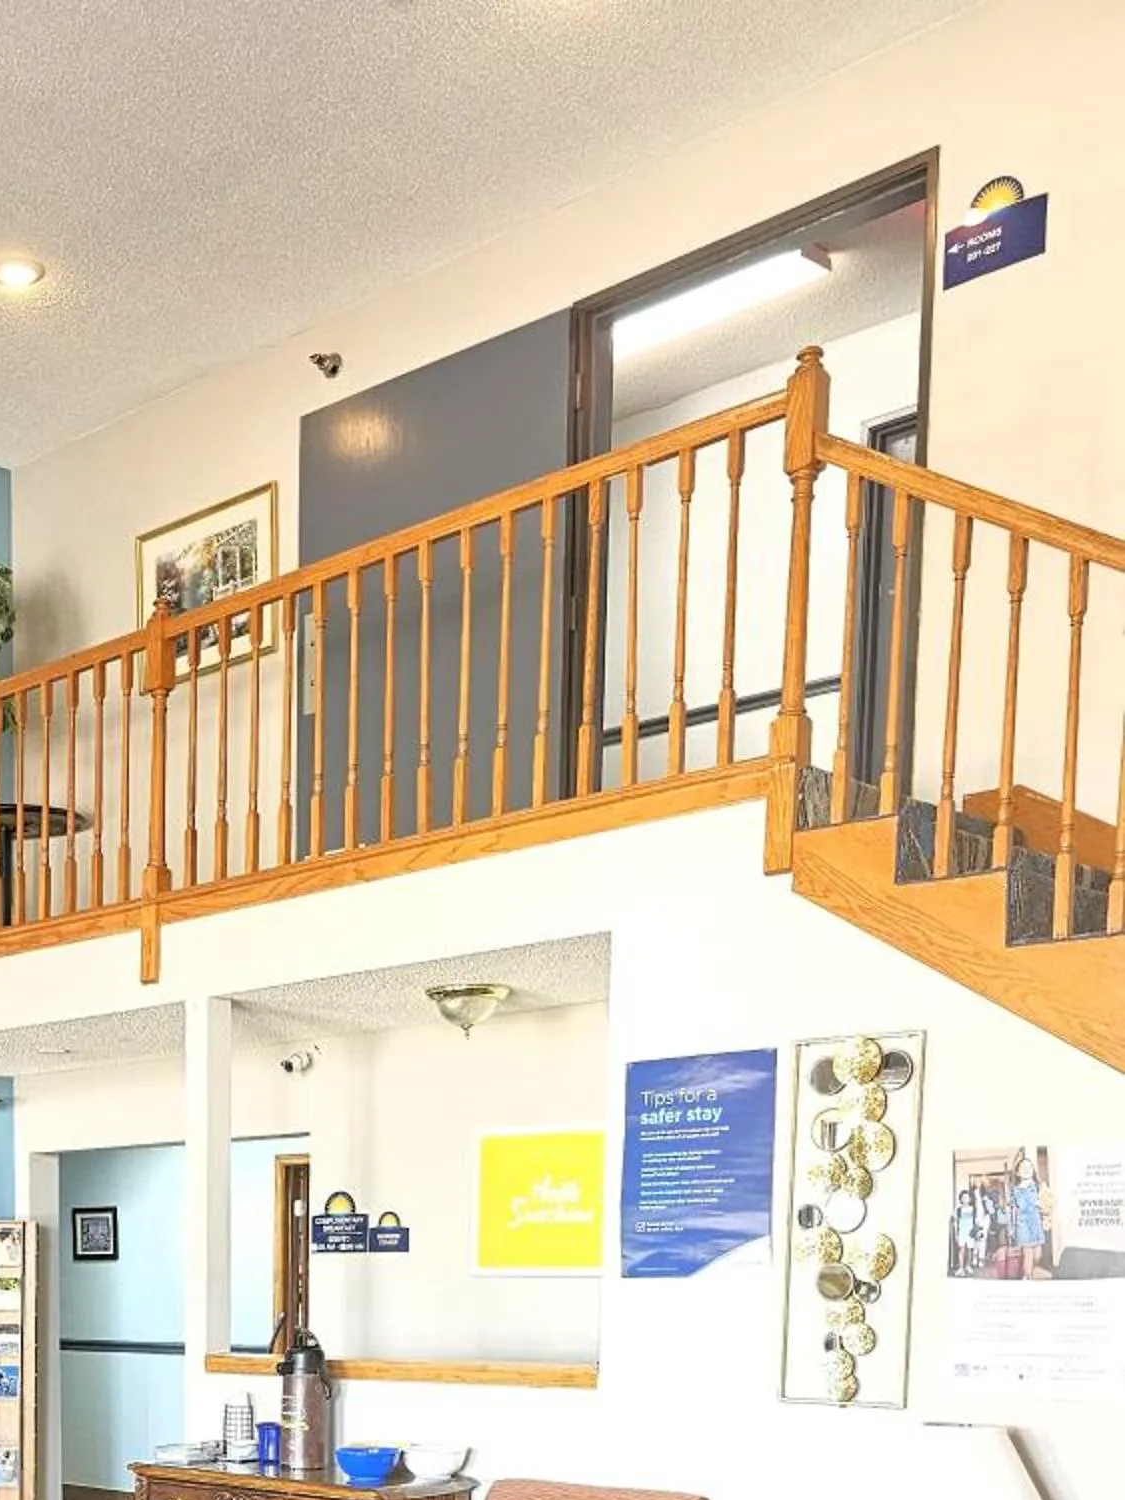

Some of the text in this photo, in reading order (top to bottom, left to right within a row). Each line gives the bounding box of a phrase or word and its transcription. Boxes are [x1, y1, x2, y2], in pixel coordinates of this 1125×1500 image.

[640, 1088, 717, 1109] Tips for a
[640, 1106, 723, 1125] safer stay
